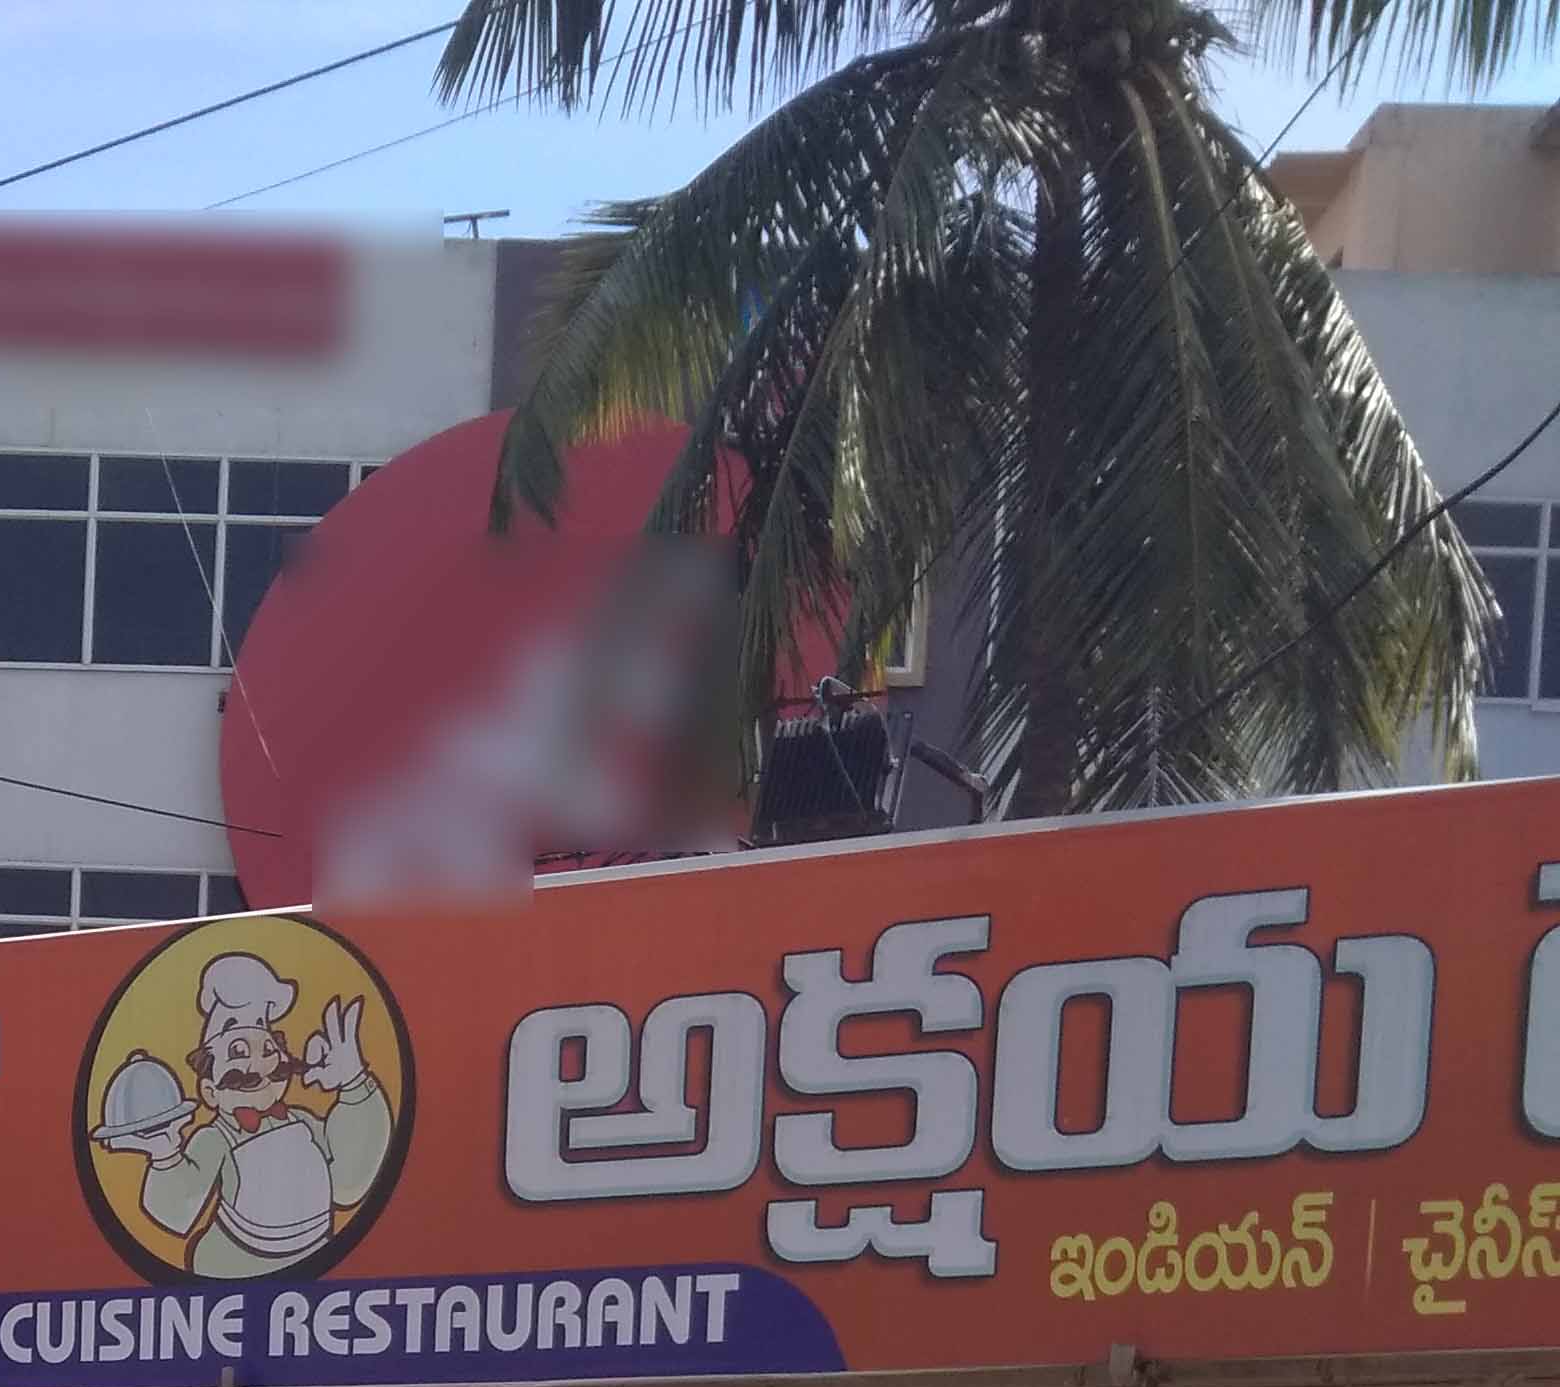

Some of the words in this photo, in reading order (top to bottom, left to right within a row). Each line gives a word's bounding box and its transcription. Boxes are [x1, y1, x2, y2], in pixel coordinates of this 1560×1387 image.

[1050, 1191, 1334, 1301] ఇండియన్
[0, 1294, 245, 1363] CUISINE
[267, 1273, 740, 1358] RESTAURANT
